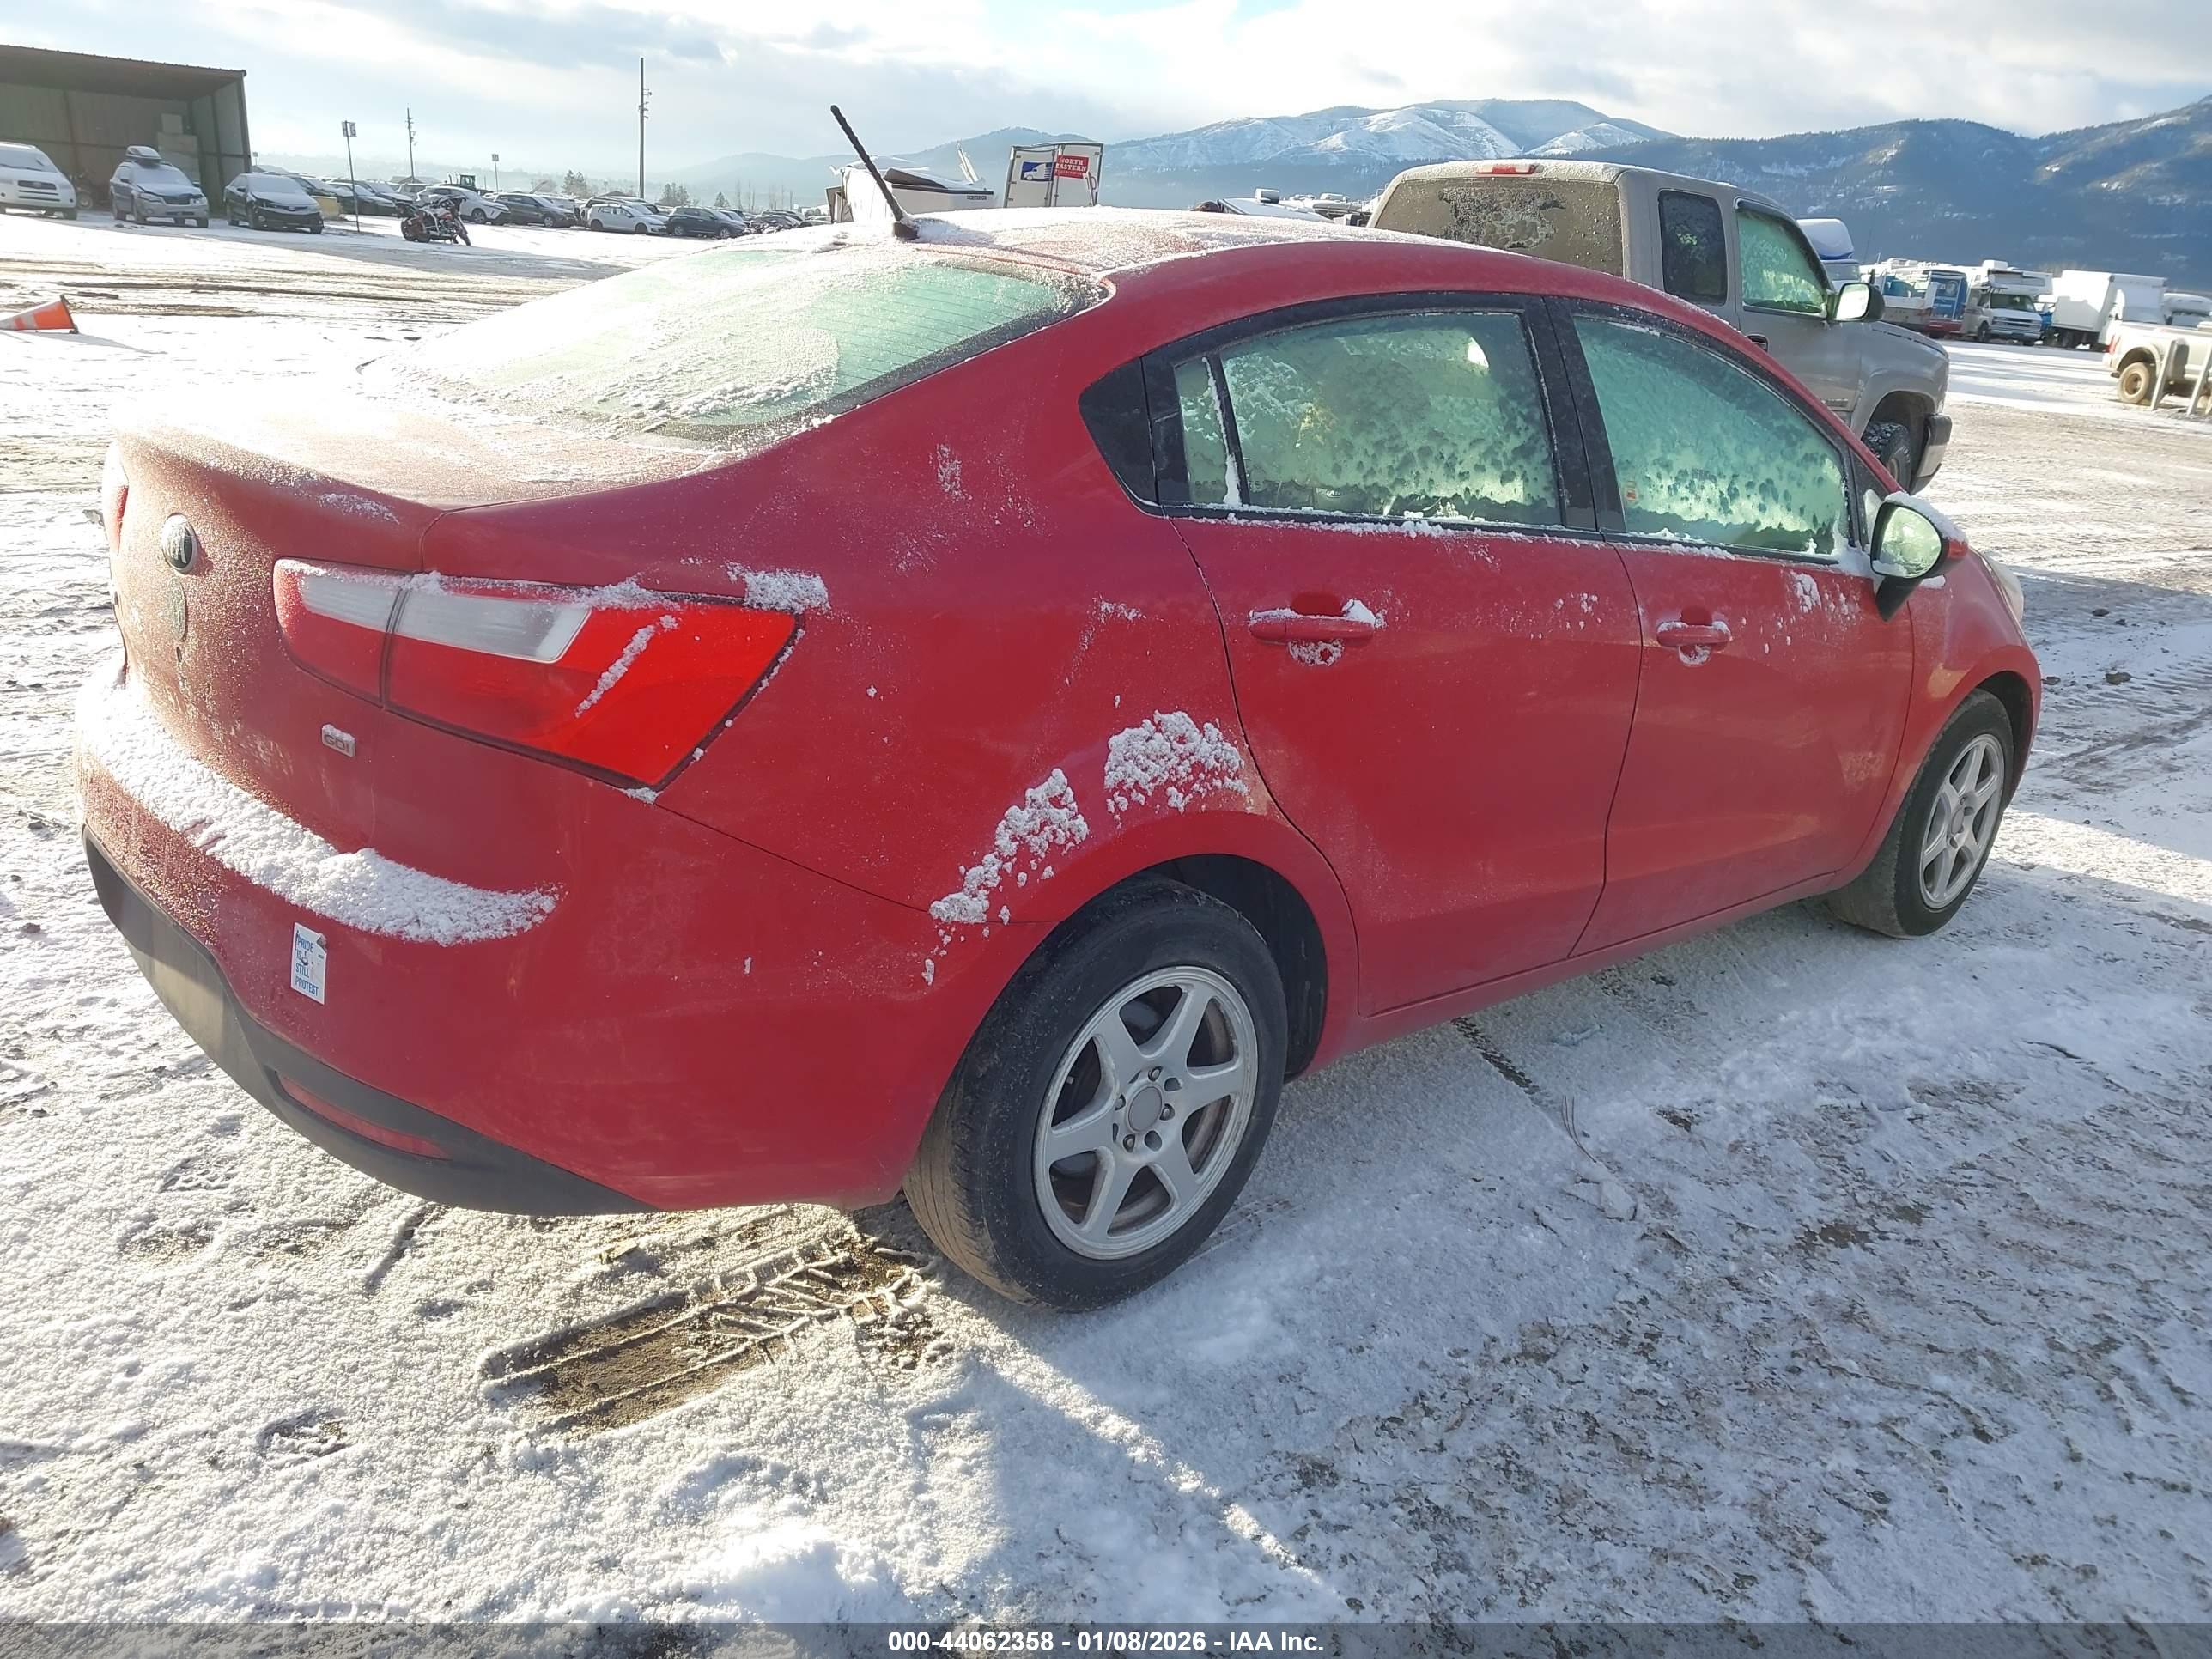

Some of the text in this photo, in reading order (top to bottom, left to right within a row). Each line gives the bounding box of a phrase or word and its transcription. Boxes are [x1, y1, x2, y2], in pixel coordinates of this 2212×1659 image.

[1055, 163, 1087, 173] EASTERN
[1059, 157, 1084, 166] NORTH
[324, 734, 349, 753] GDI
[296, 936, 314, 953] PRIDE
[296, 950, 302, 960] IS
[295, 963, 310, 978] STILL
[295, 975, 319, 997] PROTEST
